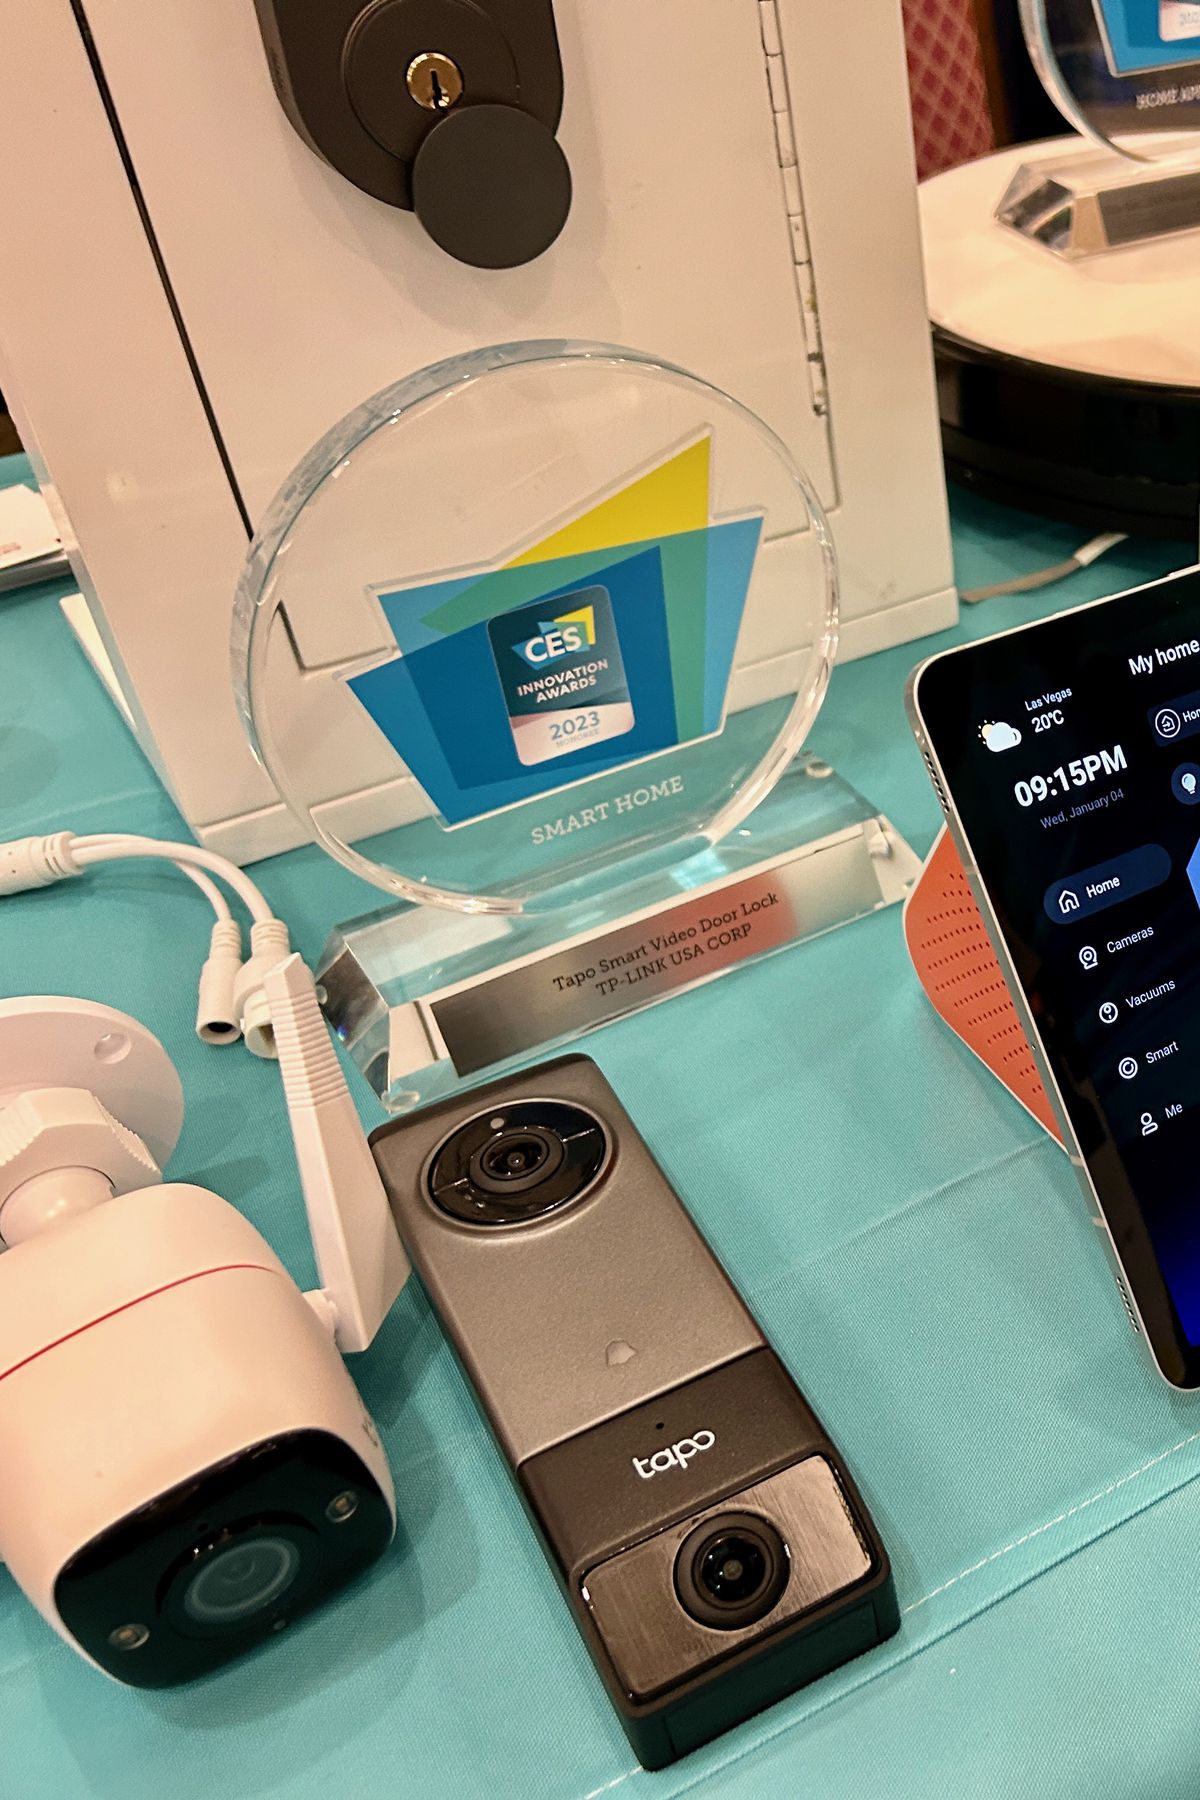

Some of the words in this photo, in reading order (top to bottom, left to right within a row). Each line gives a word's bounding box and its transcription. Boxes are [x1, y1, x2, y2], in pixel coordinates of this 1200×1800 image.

[1136, 88, 1178, 110] HOME
[524, 626, 583, 662] CES
[1128, 655, 1153, 675] My
[1155, 639, 1200, 666] home
[517, 659, 609, 696] INNOVATION
[536, 676, 597, 704] AWARDS
[1025, 699, 1043, 711] Las
[1043, 687, 1073, 707] Vegas
[549, 710, 600, 741] 2023
[1031, 709, 1065, 733] 20°C
[1014, 745, 1128, 807] 09:15PM
[531, 803, 609, 846] SMART
[616, 775, 684, 815] HOME
[1040, 812, 1068, 829] Wed,
[1069, 796, 1110, 819] January
[1110, 788, 1125, 803] 04
[1086, 876, 1121, 898] Home
[552, 968, 596, 993] Tapo
[600, 944, 648, 974] Smart
[650, 928, 697, 952] Video
[699, 911, 738, 933] Door
[741, 892, 779, 916] Lock
[1106, 926, 1155, 953] Cameras
[595, 959, 667, 996] TP-LINK
[669, 947, 705, 966] USA
[707, 922, 752, 951] CORP
[1125, 978, 1176, 1009] Vacuums
[1145, 1041, 1179, 1064] Smart
[1164, 1102, 1183, 1119] Me
[631, 1429, 717, 1479] tapo
